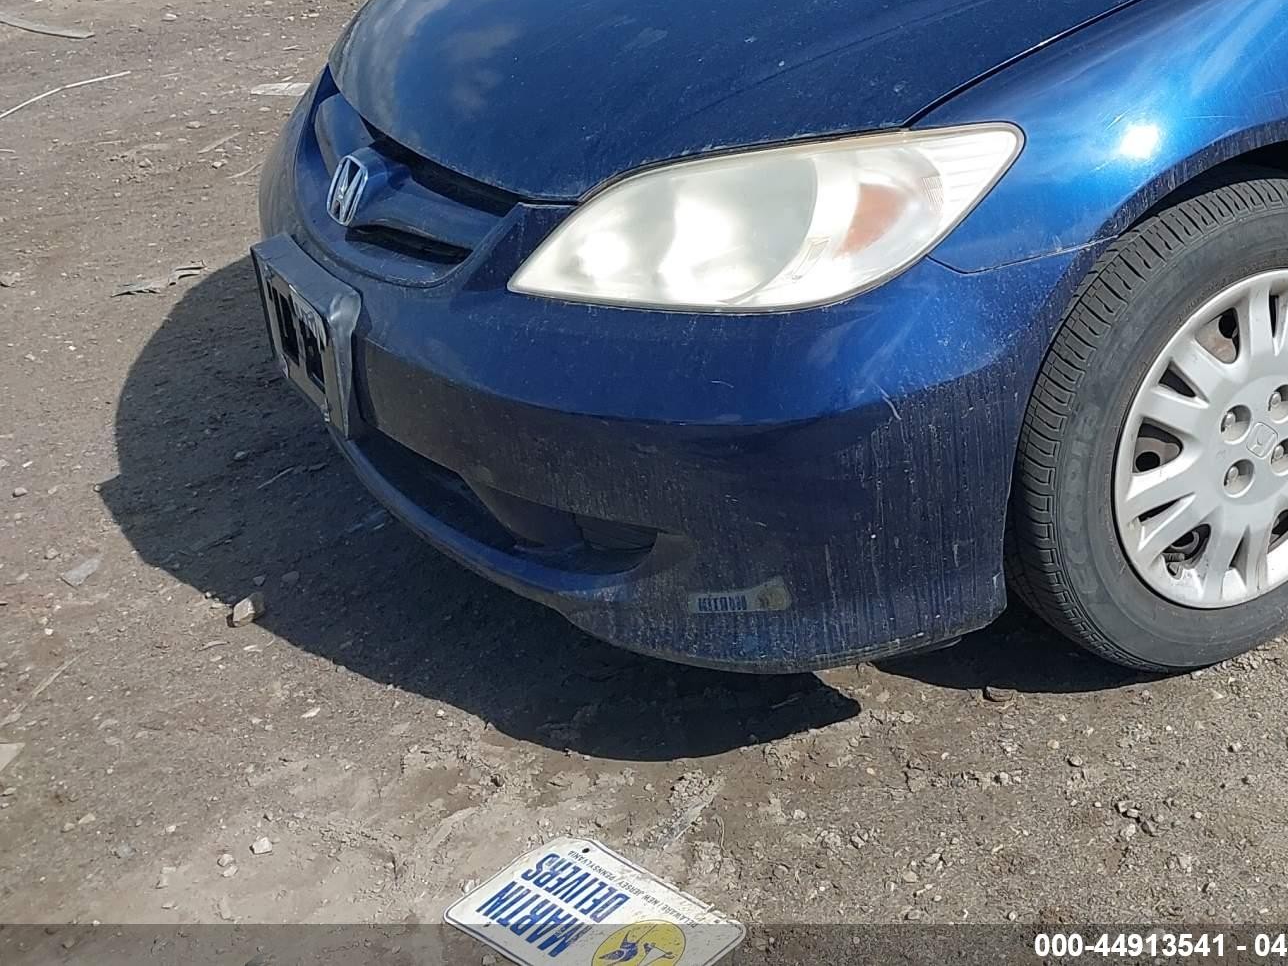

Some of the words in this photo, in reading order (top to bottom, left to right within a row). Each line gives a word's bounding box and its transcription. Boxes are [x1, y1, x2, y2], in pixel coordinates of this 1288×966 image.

[567, 849, 616, 882] PENNSYLVANIA
[520, 852, 631, 924] DELIVERS
[619, 879, 645, 900] JERSEY
[643, 893, 661, 907] NEW
[475, 881, 593, 957] MARTIN
[660, 903, 699, 929] DELAWARE
